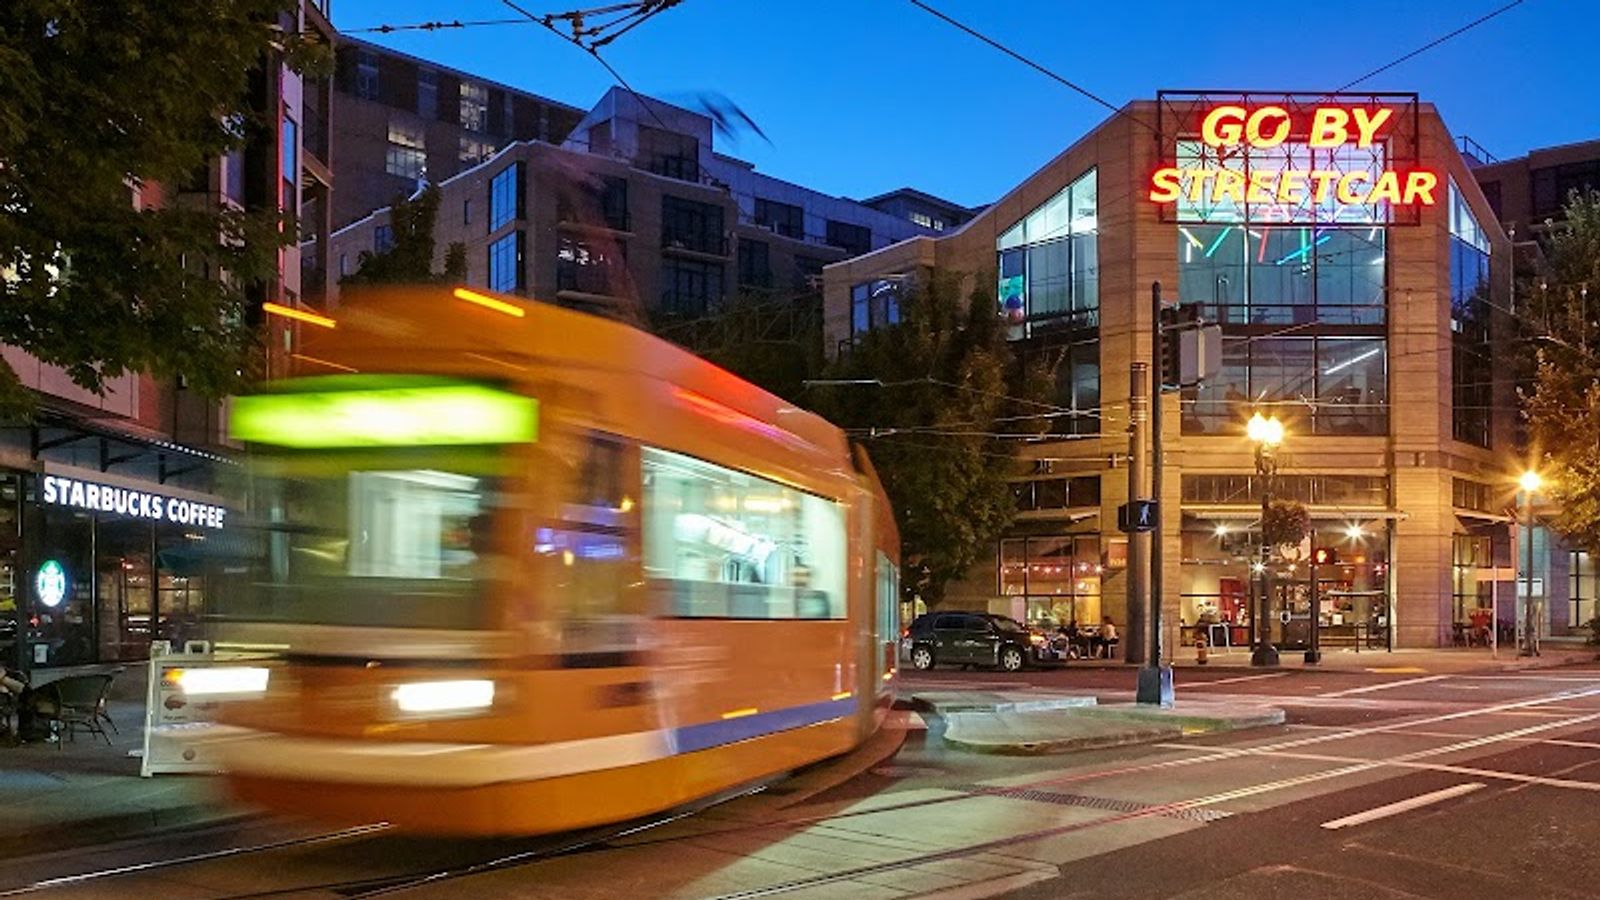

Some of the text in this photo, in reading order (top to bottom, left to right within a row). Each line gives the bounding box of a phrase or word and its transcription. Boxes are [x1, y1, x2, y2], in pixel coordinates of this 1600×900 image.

[1202, 105, 1394, 149] GO BY
[1149, 167, 1437, 206] STREETCAR
[43, 475, 225, 529] STARBUCKS COFFEE
